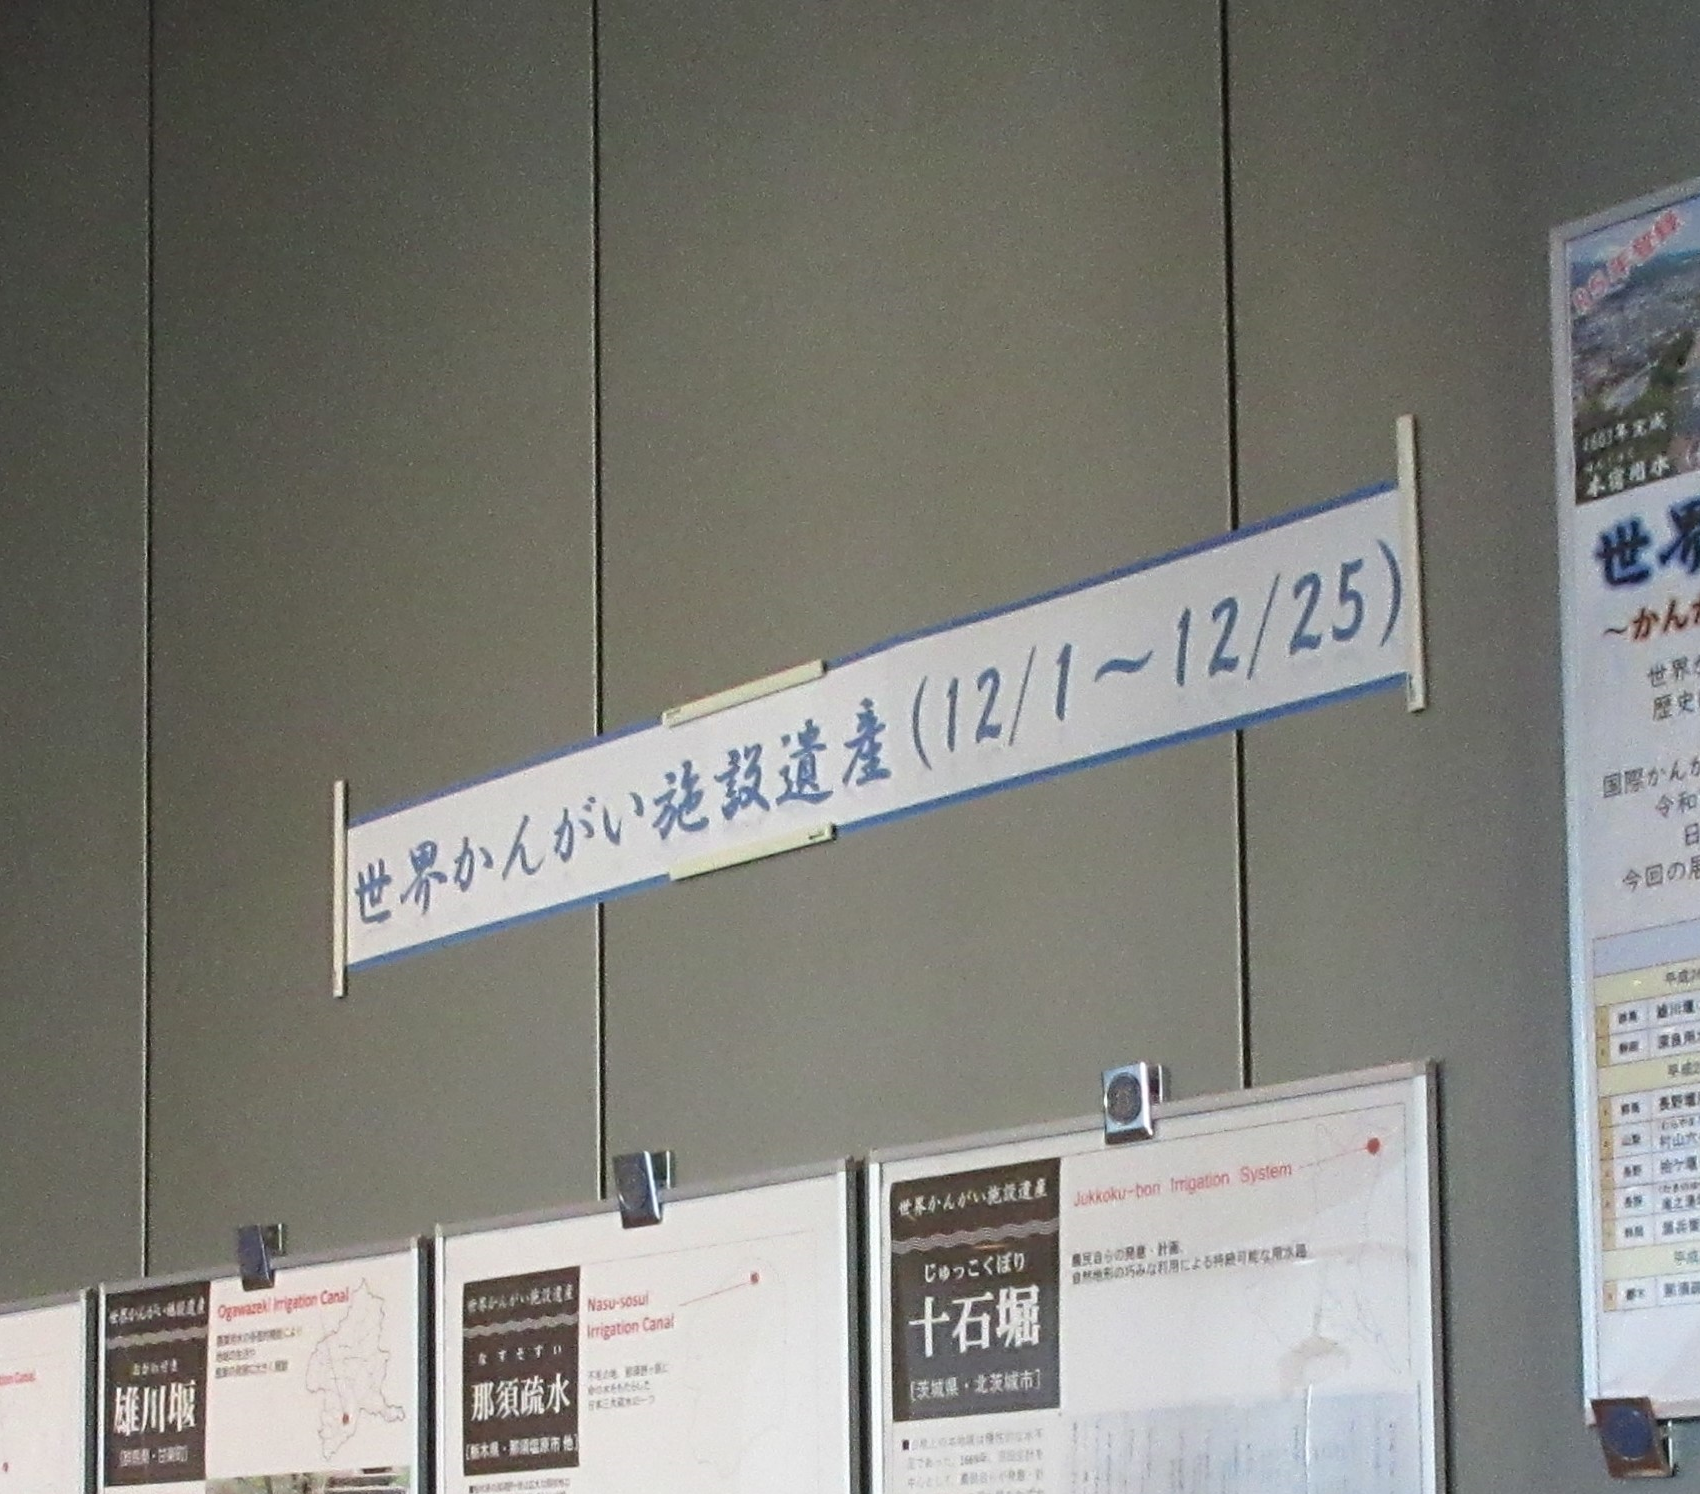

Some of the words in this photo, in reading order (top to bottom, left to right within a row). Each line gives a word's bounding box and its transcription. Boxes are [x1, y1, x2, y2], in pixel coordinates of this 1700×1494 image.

[898, 1177, 1048, 1218] 世界かんがい施設遺産
[1170, 1169, 1232, 1196] Irrigation
[1239, 1161, 1293, 1187] System
[320, 1287, 350, 1307] Canal
[587, 1316, 640, 1340] Irrigation
[642, 1313, 676, 1335] Canal
[908, 1284, 1041, 1359] 十石堀
[113, 1380, 197, 1437] 雄川堰
[471, 1373, 571, 1423] 那須疏水
